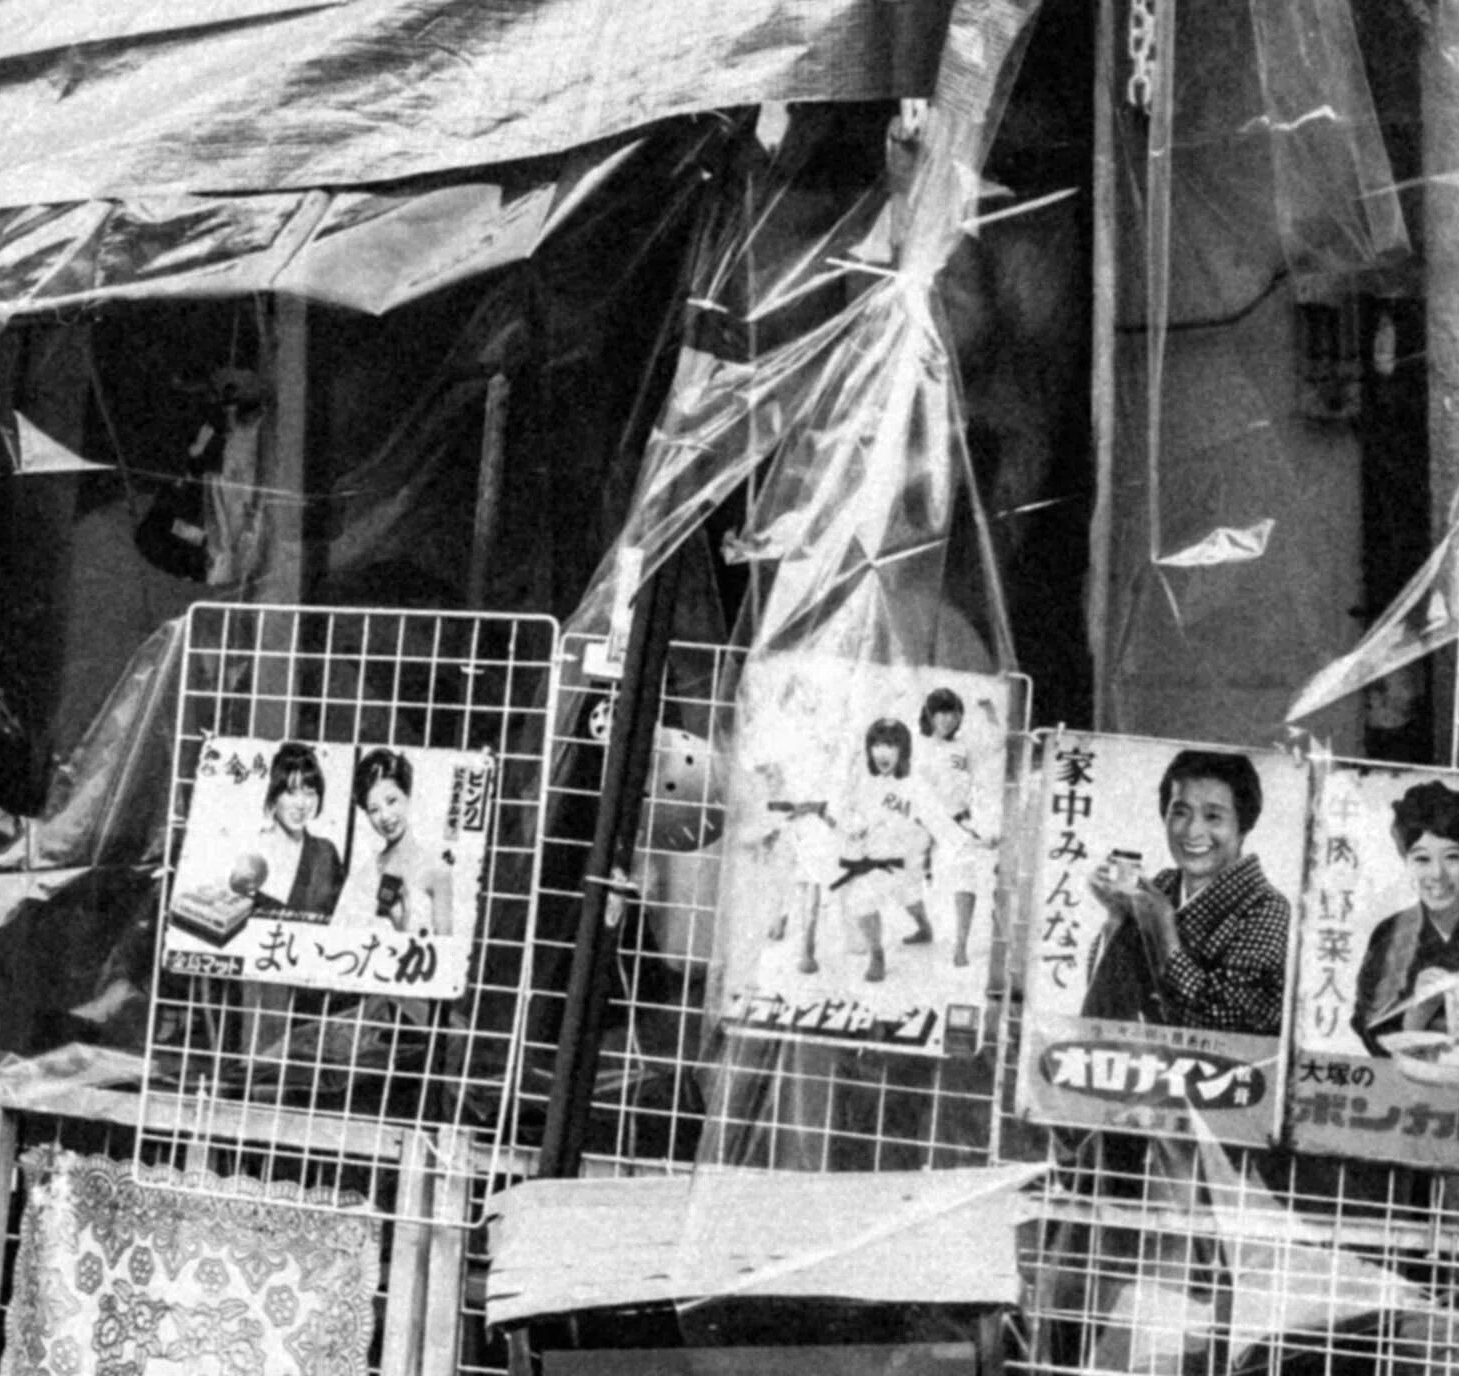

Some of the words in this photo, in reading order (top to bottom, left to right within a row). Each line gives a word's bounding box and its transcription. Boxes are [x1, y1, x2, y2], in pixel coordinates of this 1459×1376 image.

[1041, 746, 1096, 989] 家中みんなで
[1312, 792, 1360, 1037] 牛肉野菜入り
[1052, 1043, 1233, 1102] オロナイン
[1298, 1058, 1376, 1089] 大塚の
